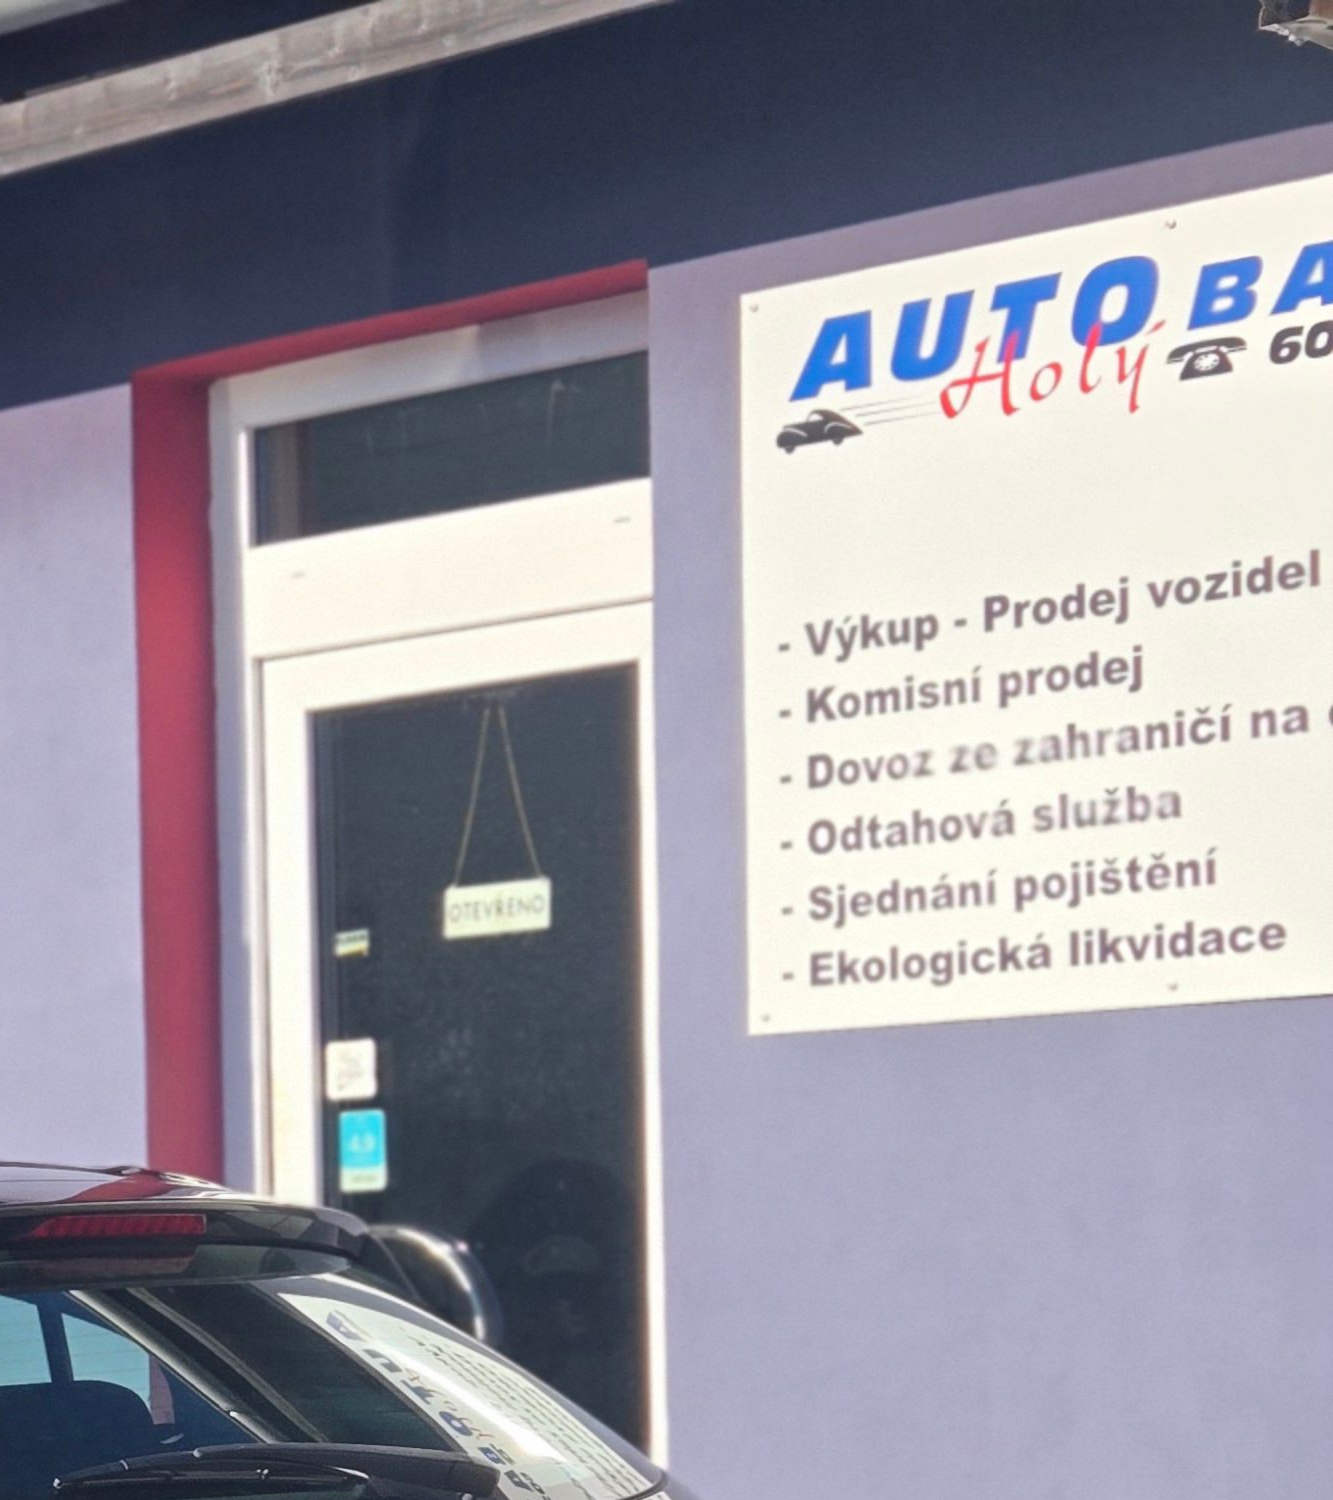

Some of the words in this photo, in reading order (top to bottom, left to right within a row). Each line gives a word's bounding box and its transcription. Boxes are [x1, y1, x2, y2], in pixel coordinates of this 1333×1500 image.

[789, 255, 1159, 402] AUTO
[939, 319, 1166, 419] Holý
[1269, 319, 1333, 365] 60
[805, 614, 939, 663] Výkup
[984, 576, 1129, 632] Prodej
[1147, 549, 1320, 608] vozidel
[807, 666, 981, 723] Komisní
[999, 645, 1142, 709] prodej
[808, 751, 933, 789] Dovoz
[950, 743, 997, 773] ze
[1014, 704, 1232, 766] zahraničí
[1251, 705, 1309, 738] na
[808, 800, 1015, 855] Odtahová
[1033, 786, 1182, 832] služba
[809, 869, 996, 929] Sjednání
[1014, 847, 1216, 912] pojištění
[810, 933, 1051, 987] Ekologická
[1070, 921, 1287, 967] likvidace
